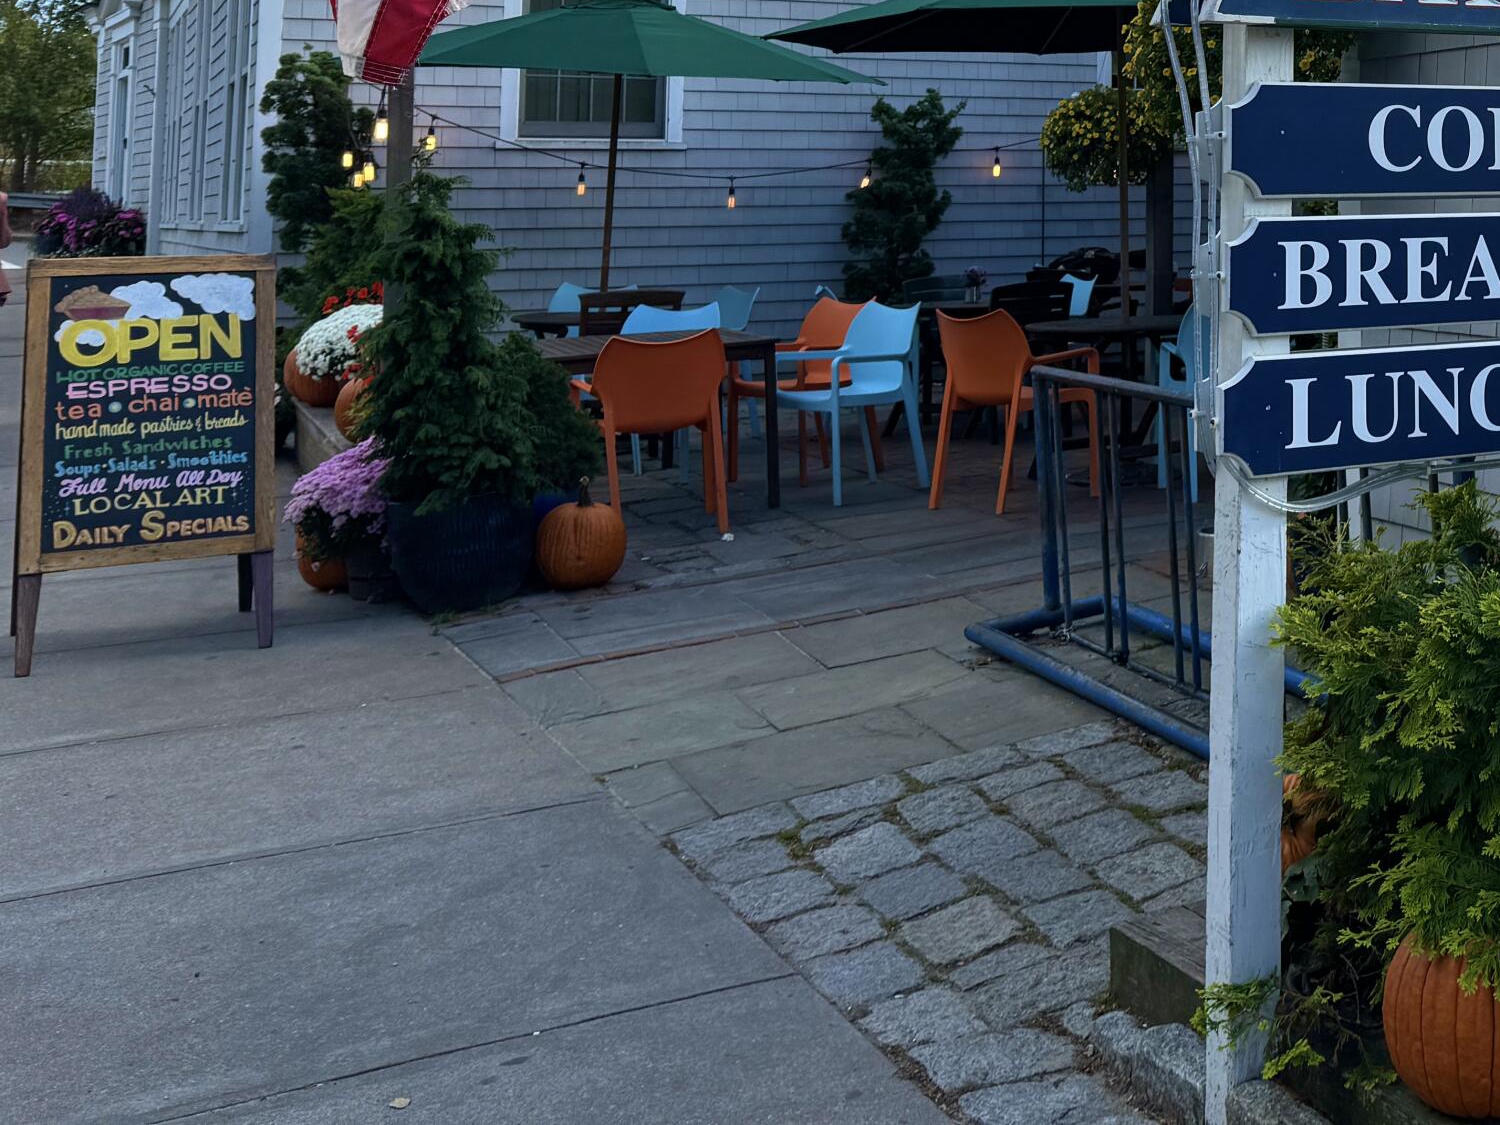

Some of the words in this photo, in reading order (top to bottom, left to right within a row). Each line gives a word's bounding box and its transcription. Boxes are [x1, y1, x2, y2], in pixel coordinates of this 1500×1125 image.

[59, 313, 242, 367] OPEN
[56, 367, 101, 384] HOT
[103, 363, 178, 380] ORGANIC
[180, 361, 245, 376] COFFEE
[66, 374, 232, 400] ESPRESSO
[55, 401, 102, 421] tea
[128, 393, 179, 414] chai
[140, 415, 193, 439] pastries
[204, 410, 249, 431] breads
[64, 442, 113, 459] Fresh
[122, 436, 232, 456] Sandwiches
[54, 459, 101, 478] Soups
[107, 454, 156, 473] Salads
[167, 450, 248, 469] Smoothies
[59, 477, 107, 498] Full
[114, 473, 170, 493] Menu
[175, 469, 204, 483] All
[206, 469, 244, 488] Day
[72, 490, 170, 516] LOCAL
[175, 486, 229, 506] ART
